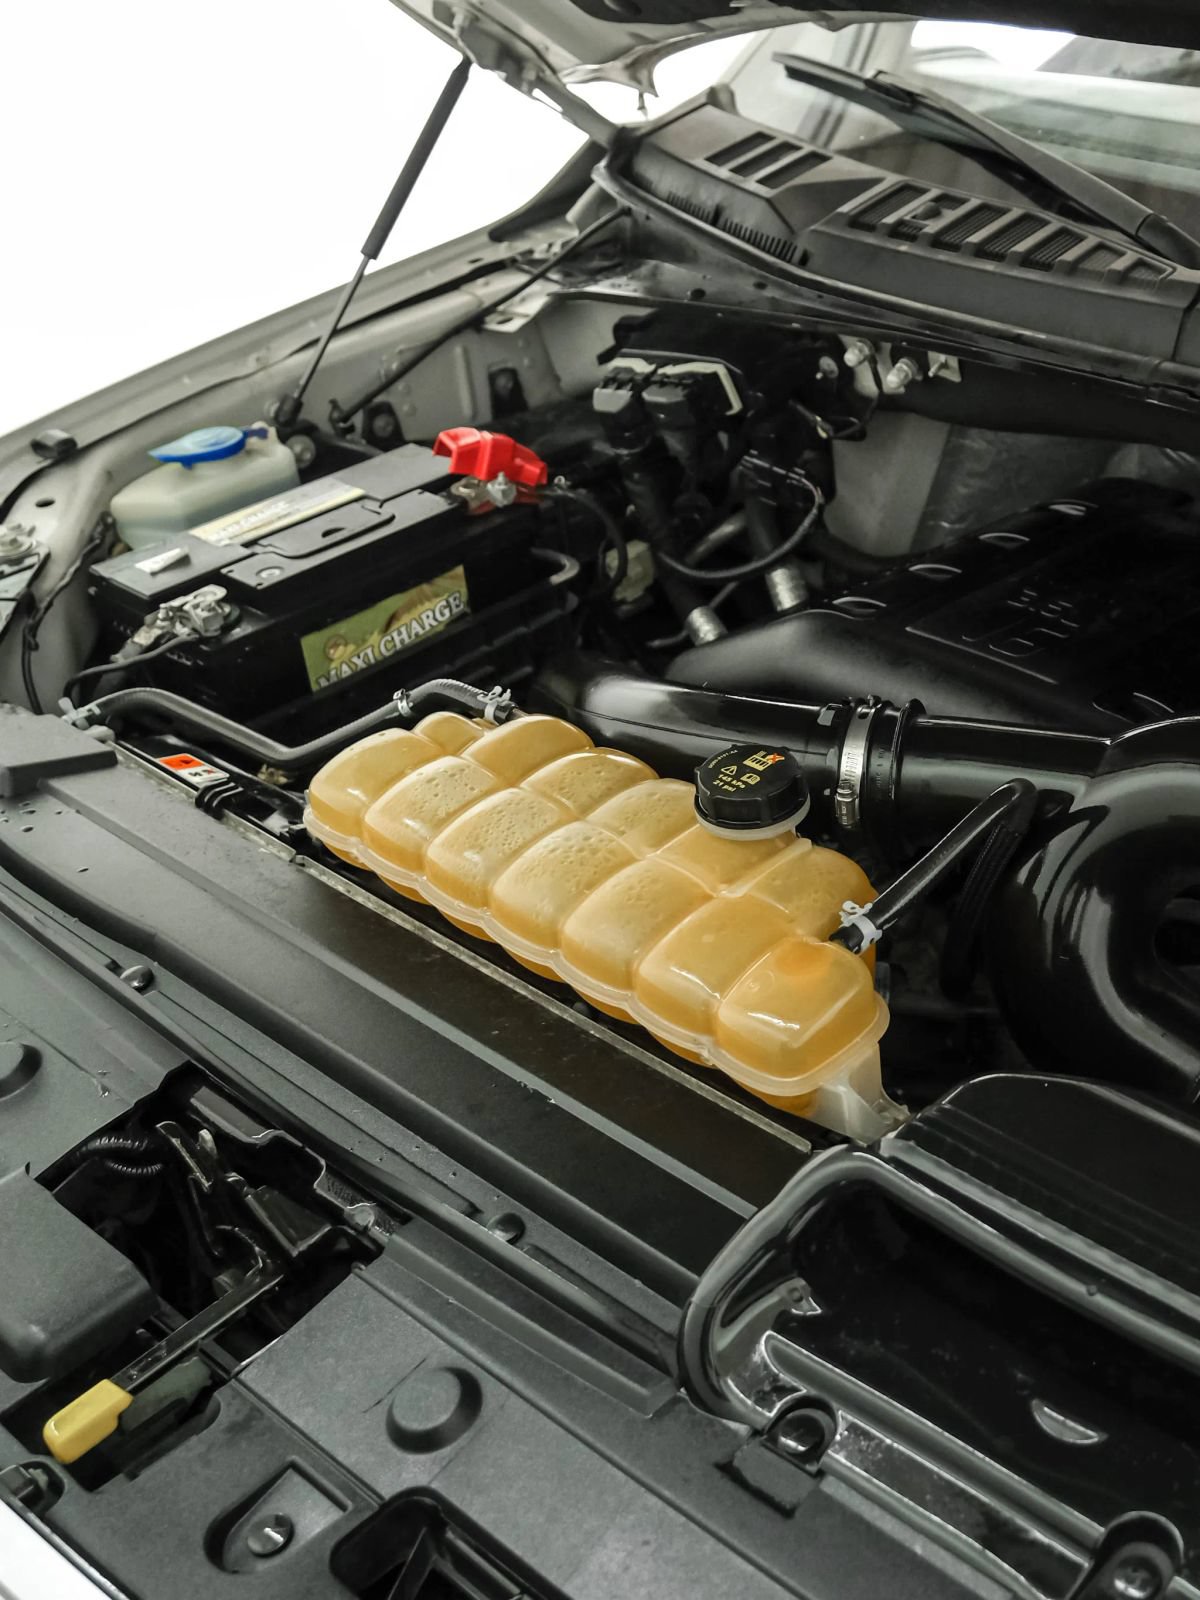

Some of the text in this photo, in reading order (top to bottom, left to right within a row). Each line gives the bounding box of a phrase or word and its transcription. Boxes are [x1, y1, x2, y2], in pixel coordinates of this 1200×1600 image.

[316, 591, 465, 689] MAXI CHARGE
[718, 774, 746, 788] 145 kPa
